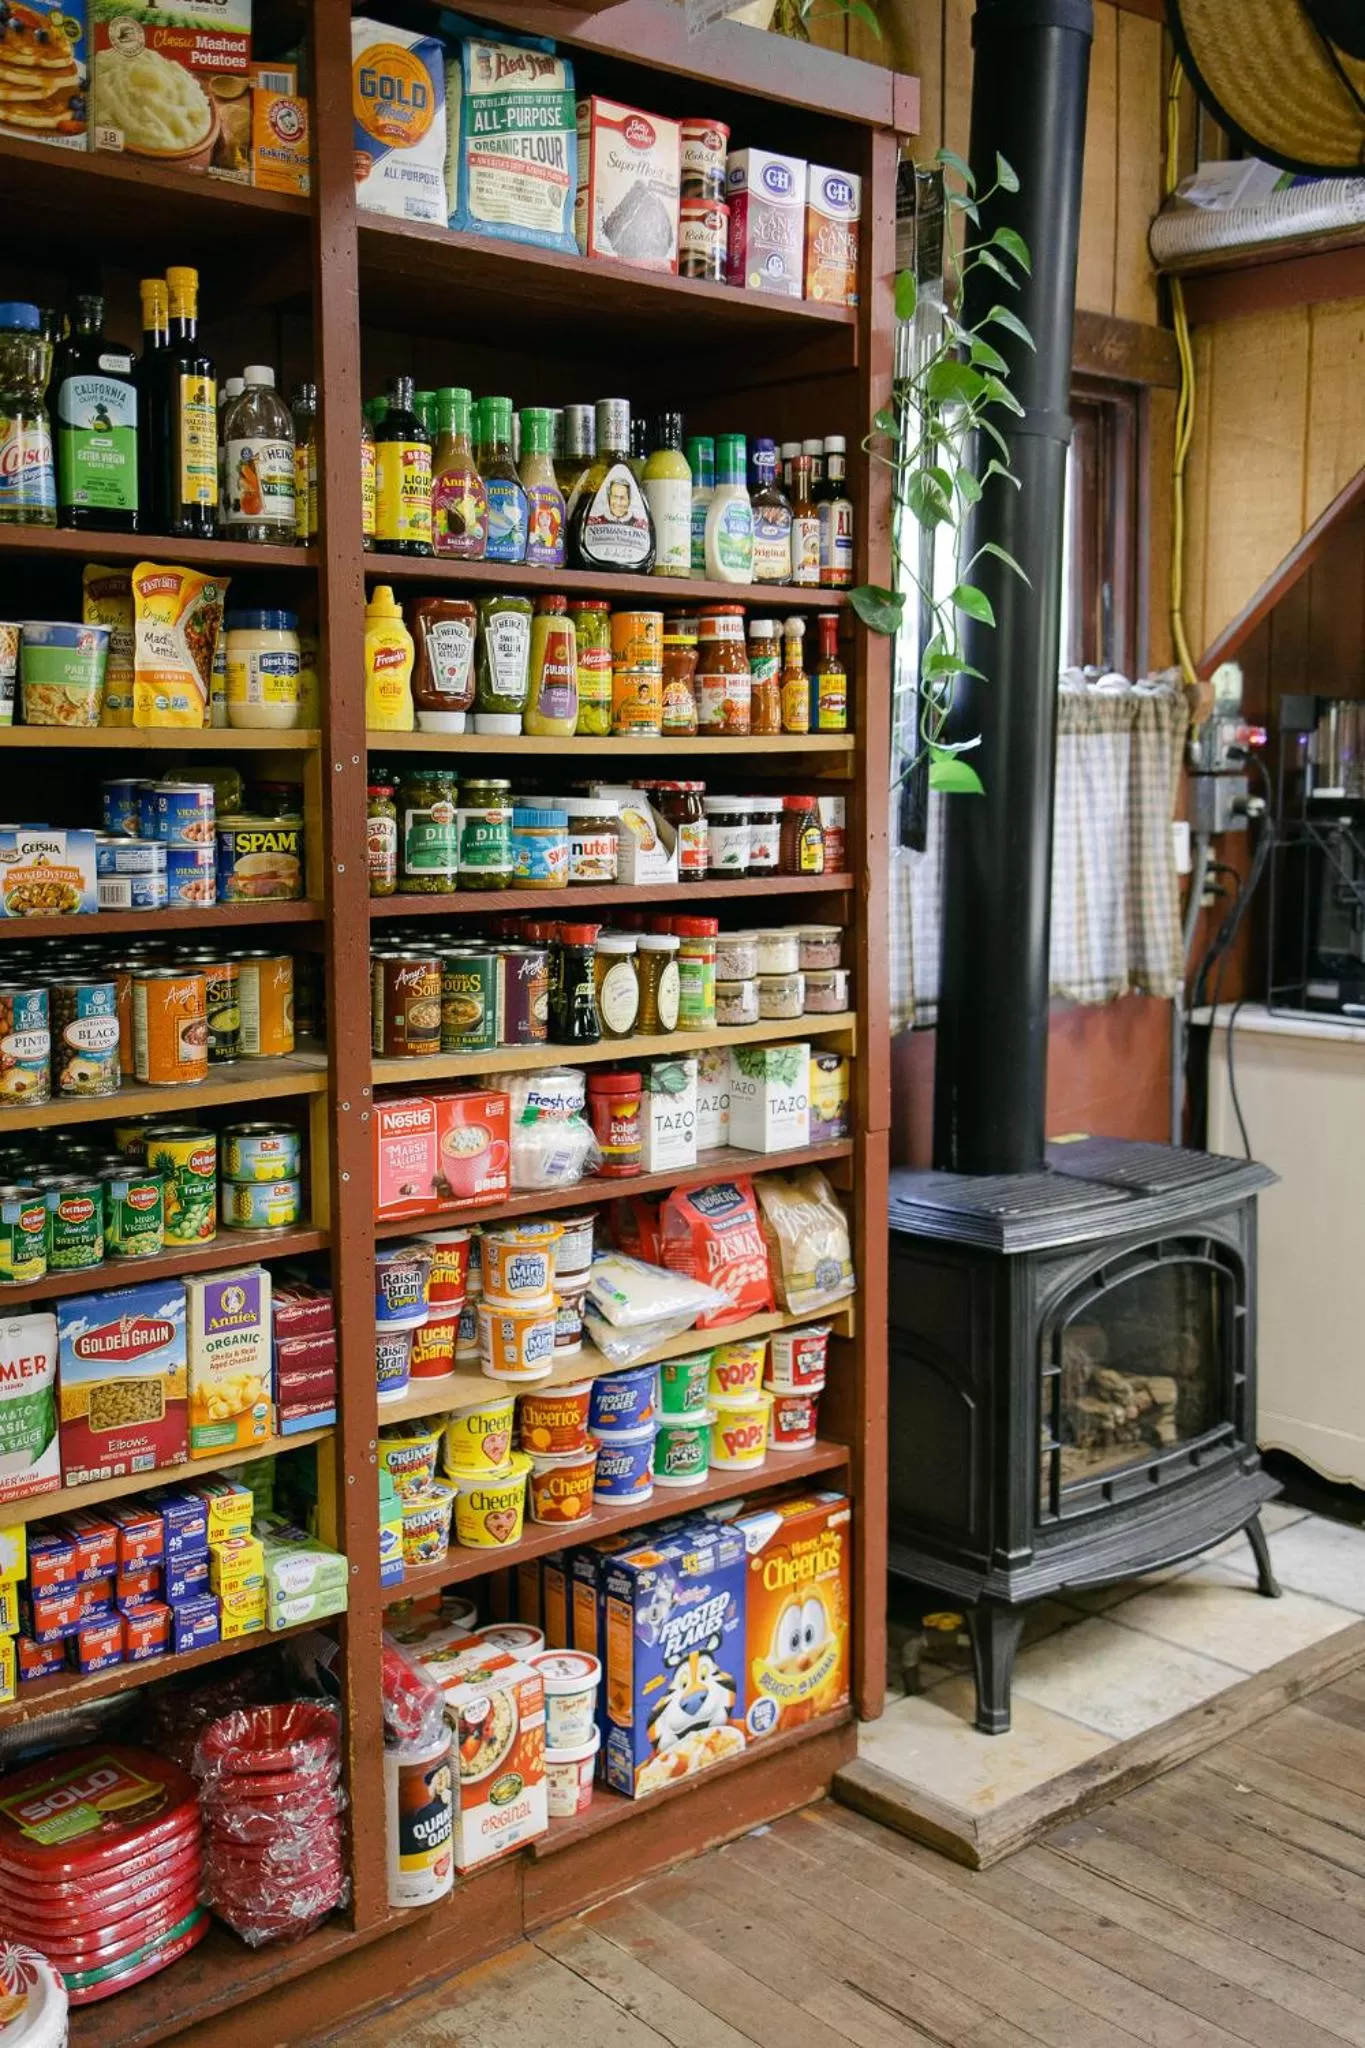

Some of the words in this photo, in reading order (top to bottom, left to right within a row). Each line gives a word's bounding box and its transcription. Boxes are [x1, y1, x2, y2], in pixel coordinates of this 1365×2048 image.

[195, 35, 246, 53] Mashed
[191, 51, 247, 67] Potatoes
[494, 52, 526, 81] Red
[359, 68, 427, 109] GOLD
[474, 107, 563, 132] ALL-PURPOSE
[103, 130, 117, 143] 18
[474, 139, 520, 156] ORGANIC
[520, 136, 564, 169] FLOUR
[74, 383, 127, 403] CALIFORNIA
[436, 642, 467, 651] TOMATO
[262, 656, 282, 667] Best
[21, 843, 61, 855] GEISHA
[236, 832, 297, 853] SPAM
[394, 965, 427, 991] Amy's
[444, 974, 481, 992] OUPS
[78, 1029, 117, 1040] BLACK
[730, 1079, 757, 1096] TAZO
[527, 1091, 563, 1110] Fresh
[769, 1094, 808, 1115] TAZO
[655, 1110, 695, 1132] TAZO
[183, 1184, 204, 1195] Fruit
[511, 1263, 545, 1277] Mini
[382, 1271, 422, 1289] Raisin
[387, 1283, 417, 1299] Bran
[208, 1310, 258, 1331] Annie's
[81, 1332, 130, 1355] GOLDEN
[131, 1326, 169, 1347] GRAIN
[205, 1333, 260, 1353] ORGANIC
[417, 1325, 455, 1344] Lucky
[211, 1351, 233, 1362] Shells
[240, 1346, 256, 1356] Real
[411, 1343, 455, 1363] Charms
[209, 1361, 229, 1371] Aged
[229, 1354, 258, 1366] Cheddar
[715, 1361, 759, 1392] POPS
[597, 1390, 638, 1404] FROSTED
[600, 1399, 635, 1412] FLAKES
[523, 1404, 581, 1425] Cheerios
[11, 1430, 42, 1446] SAUCE
[108, 1435, 148, 1452] Elbows
[722, 1424, 764, 1456] POPS
[665, 1449, 701, 1472] JACKS
[169, 1536, 183, 1547] 45
[210, 1528, 225, 1538] 100
[763, 1545, 841, 1591] Cheerios
[171, 1581, 185, 1592] 45
[224, 1580, 239, 1591] 100
[659, 1590, 731, 1644] FROSTED
[180, 1632, 194, 1643] 45
[224, 1624, 240, 1635] 100
[664, 1615, 724, 1659] FLAKES
[20, 1767, 120, 1821] SOLO
